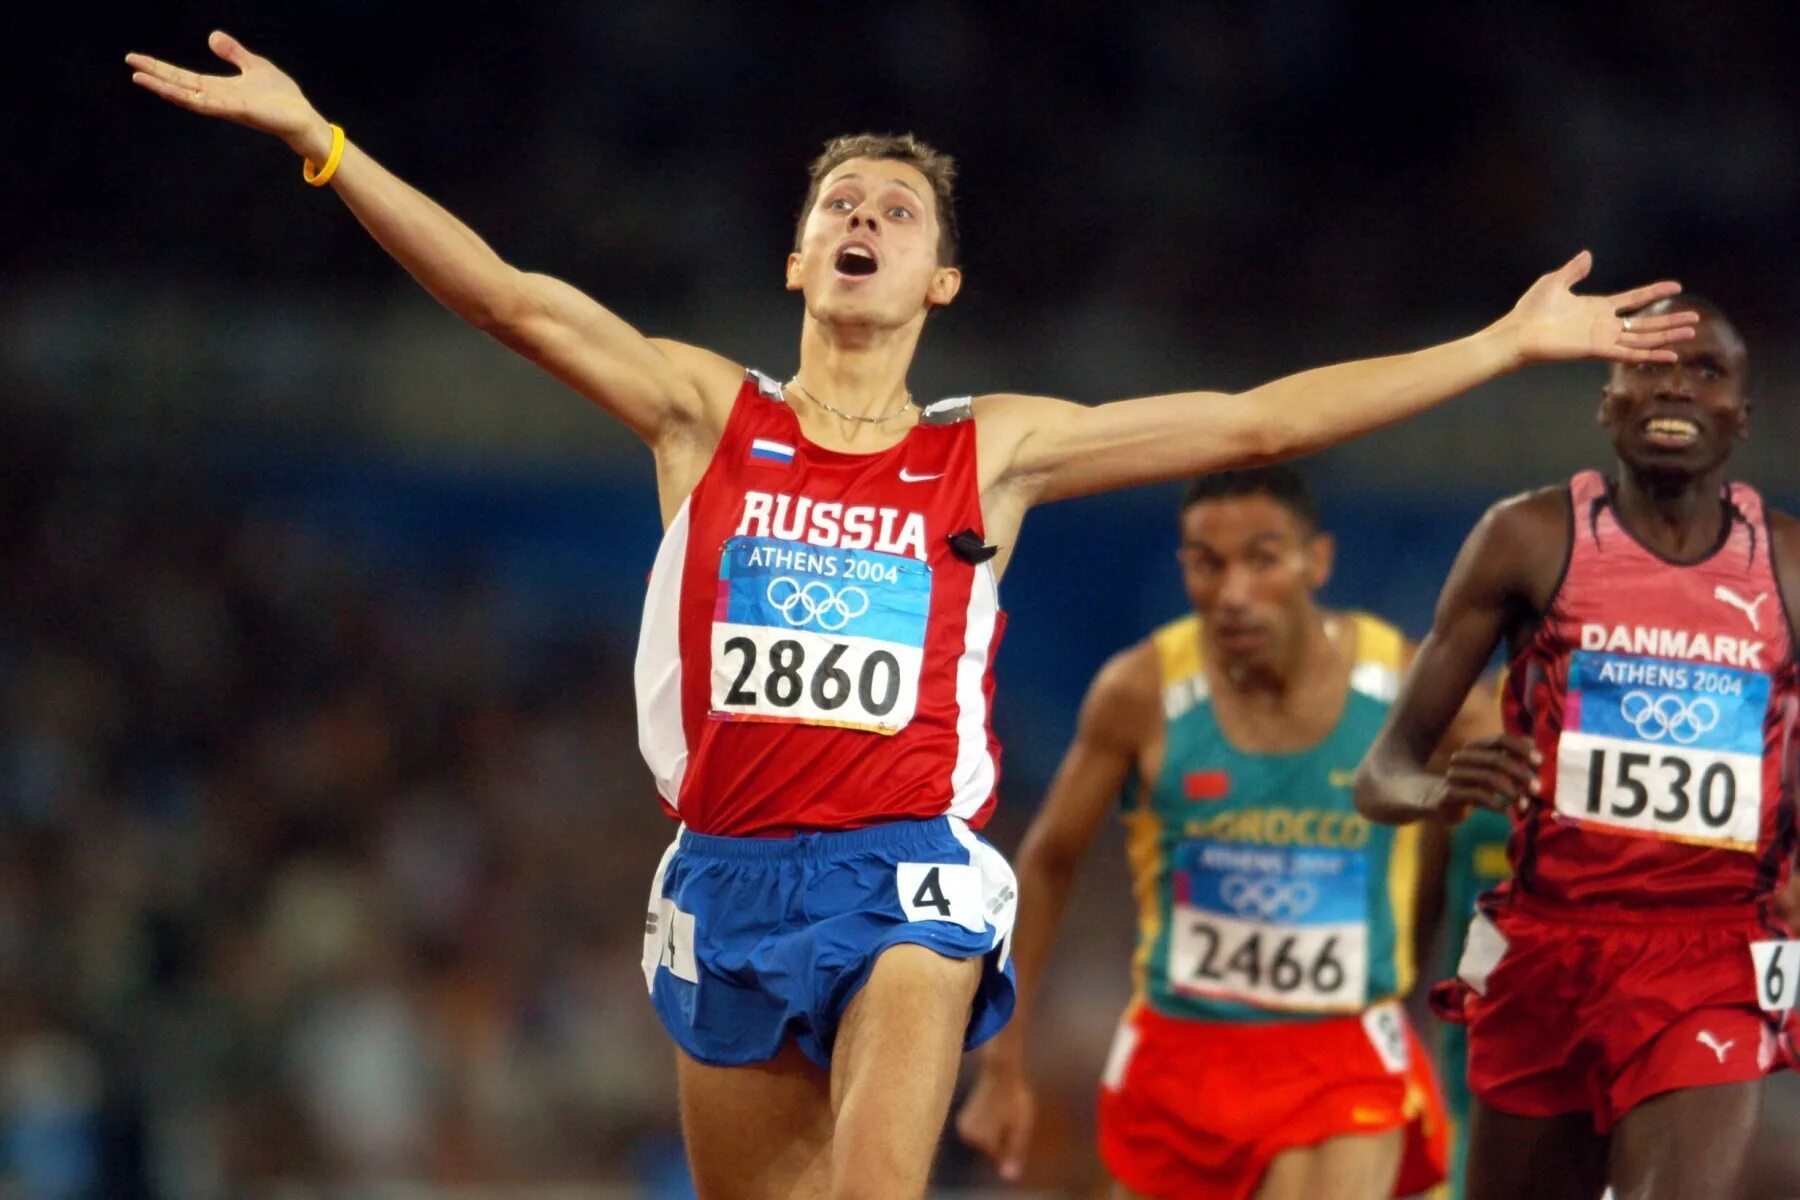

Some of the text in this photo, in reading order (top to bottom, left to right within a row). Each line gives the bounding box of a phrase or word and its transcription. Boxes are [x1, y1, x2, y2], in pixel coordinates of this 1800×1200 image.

[735, 491, 928, 562] RUSSIA
[748, 547, 898, 584] ATHENS 2004
[723, 636, 901, 717] 2860
[1582, 624, 1764, 669] DANMARK
[1599, 661, 1742, 696] ATHENS 2004
[1586, 748, 1736, 827] 1530
[912, 866, 951, 917] 4
[1190, 923, 1345, 994] 2466
[1766, 945, 1784, 1005] 6
